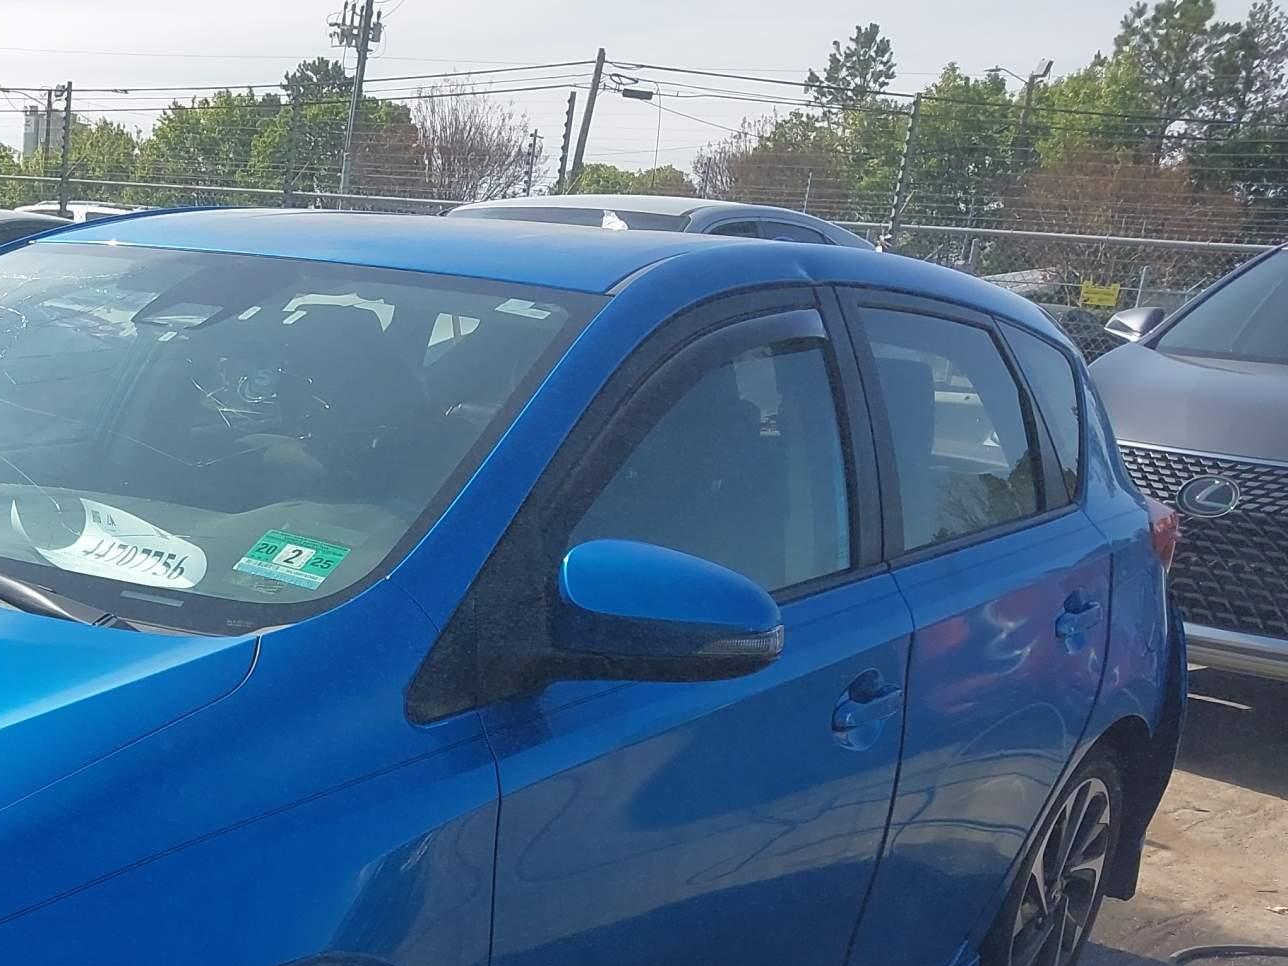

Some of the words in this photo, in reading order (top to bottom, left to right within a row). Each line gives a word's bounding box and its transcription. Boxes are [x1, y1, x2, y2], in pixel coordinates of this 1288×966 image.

[82, 539, 190, 580] 44707756
[256, 542, 278, 556] 20
[283, 549, 304, 565] 2
[311, 557, 335, 570] 25
